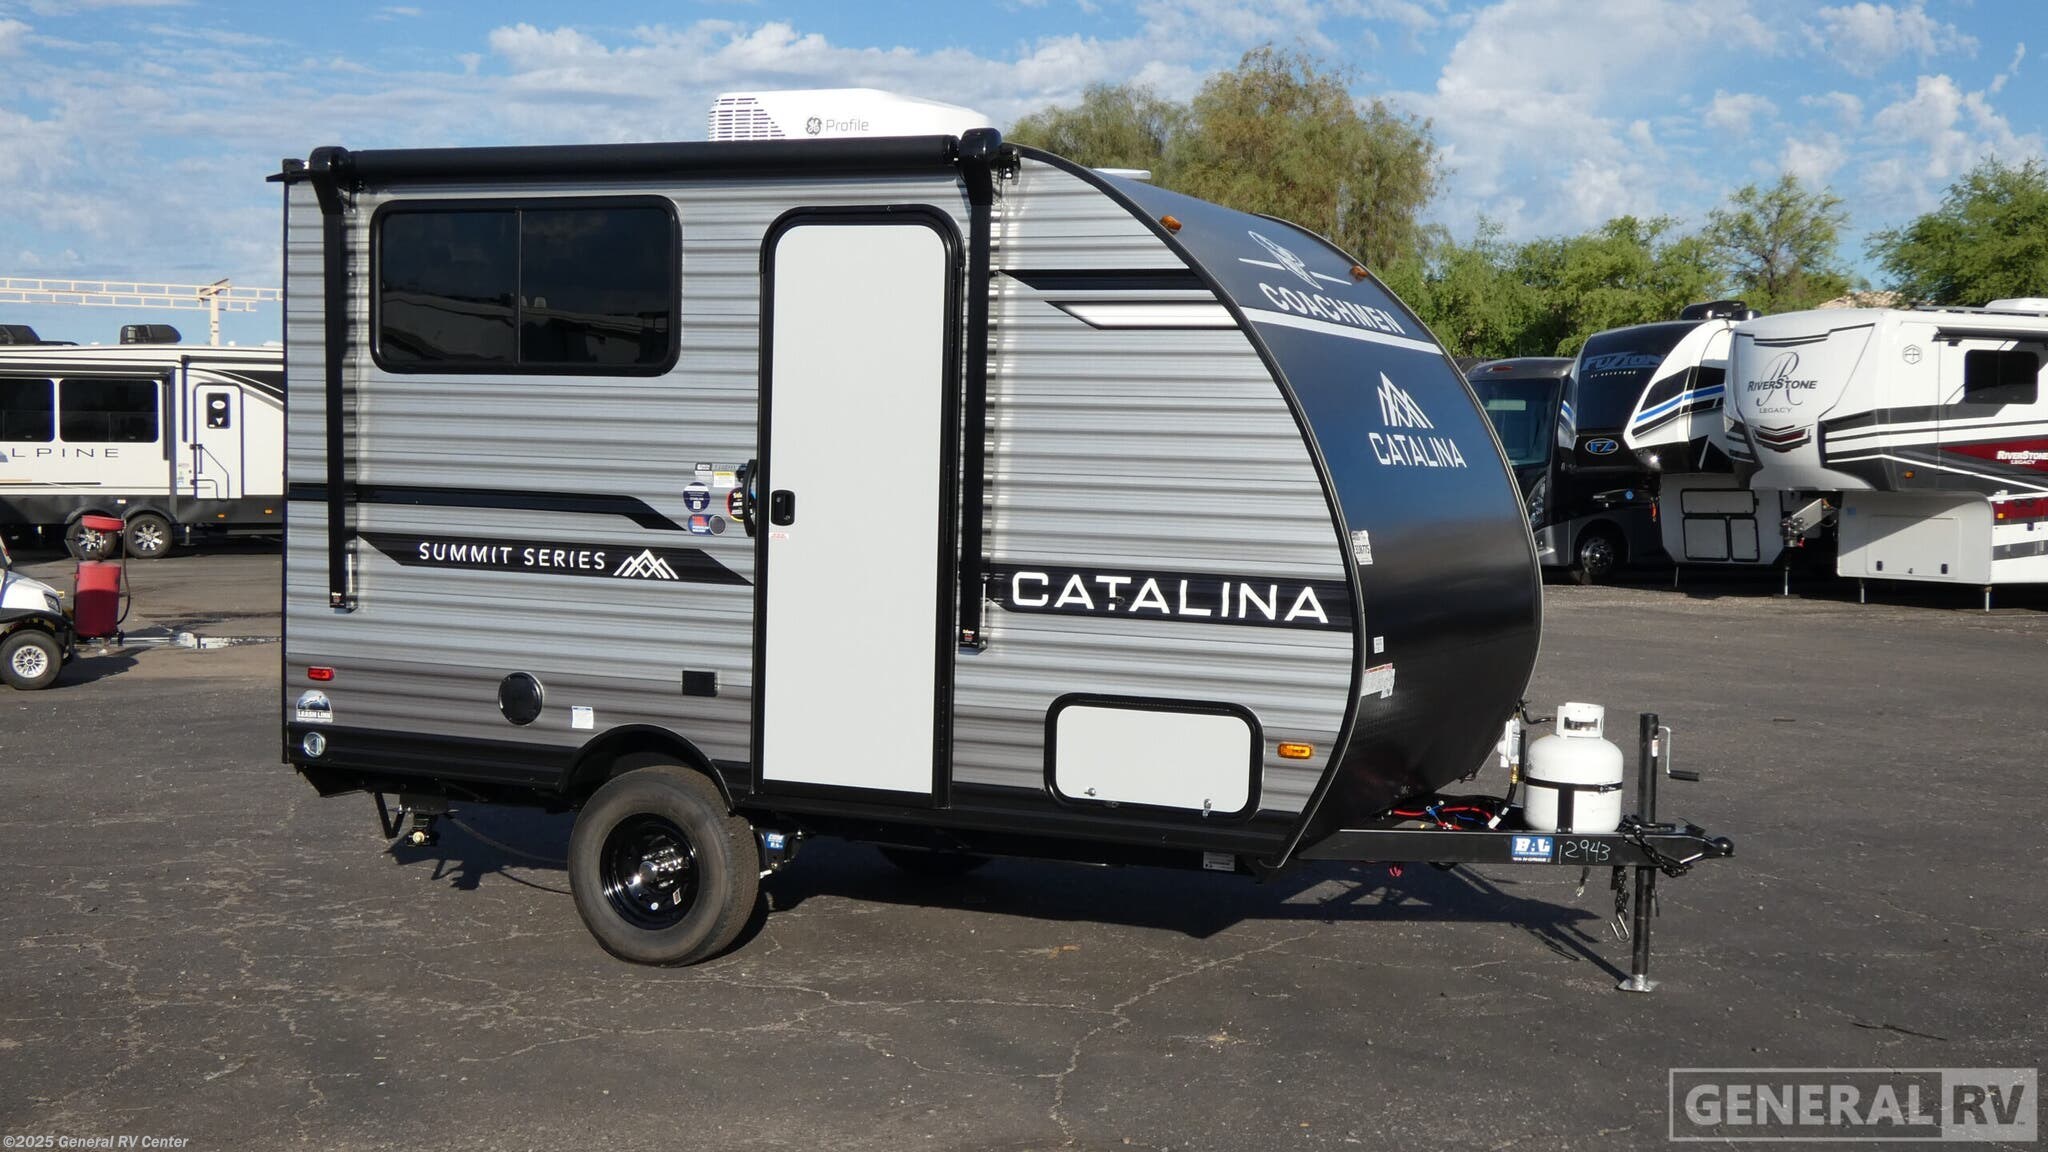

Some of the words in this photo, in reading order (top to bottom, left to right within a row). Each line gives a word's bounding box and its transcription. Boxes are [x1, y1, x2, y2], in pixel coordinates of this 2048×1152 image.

[826, 118, 869, 131] Profile
[1259, 282, 1406, 335] COACHMEN
[1368, 432, 1467, 468] CATALINA
[419, 542, 512, 564] SUMMIT
[523, 548, 606, 570] SERIES
[1012, 571, 1329, 624] CATALINA
[1559, 840, 1611, 864] 12943
